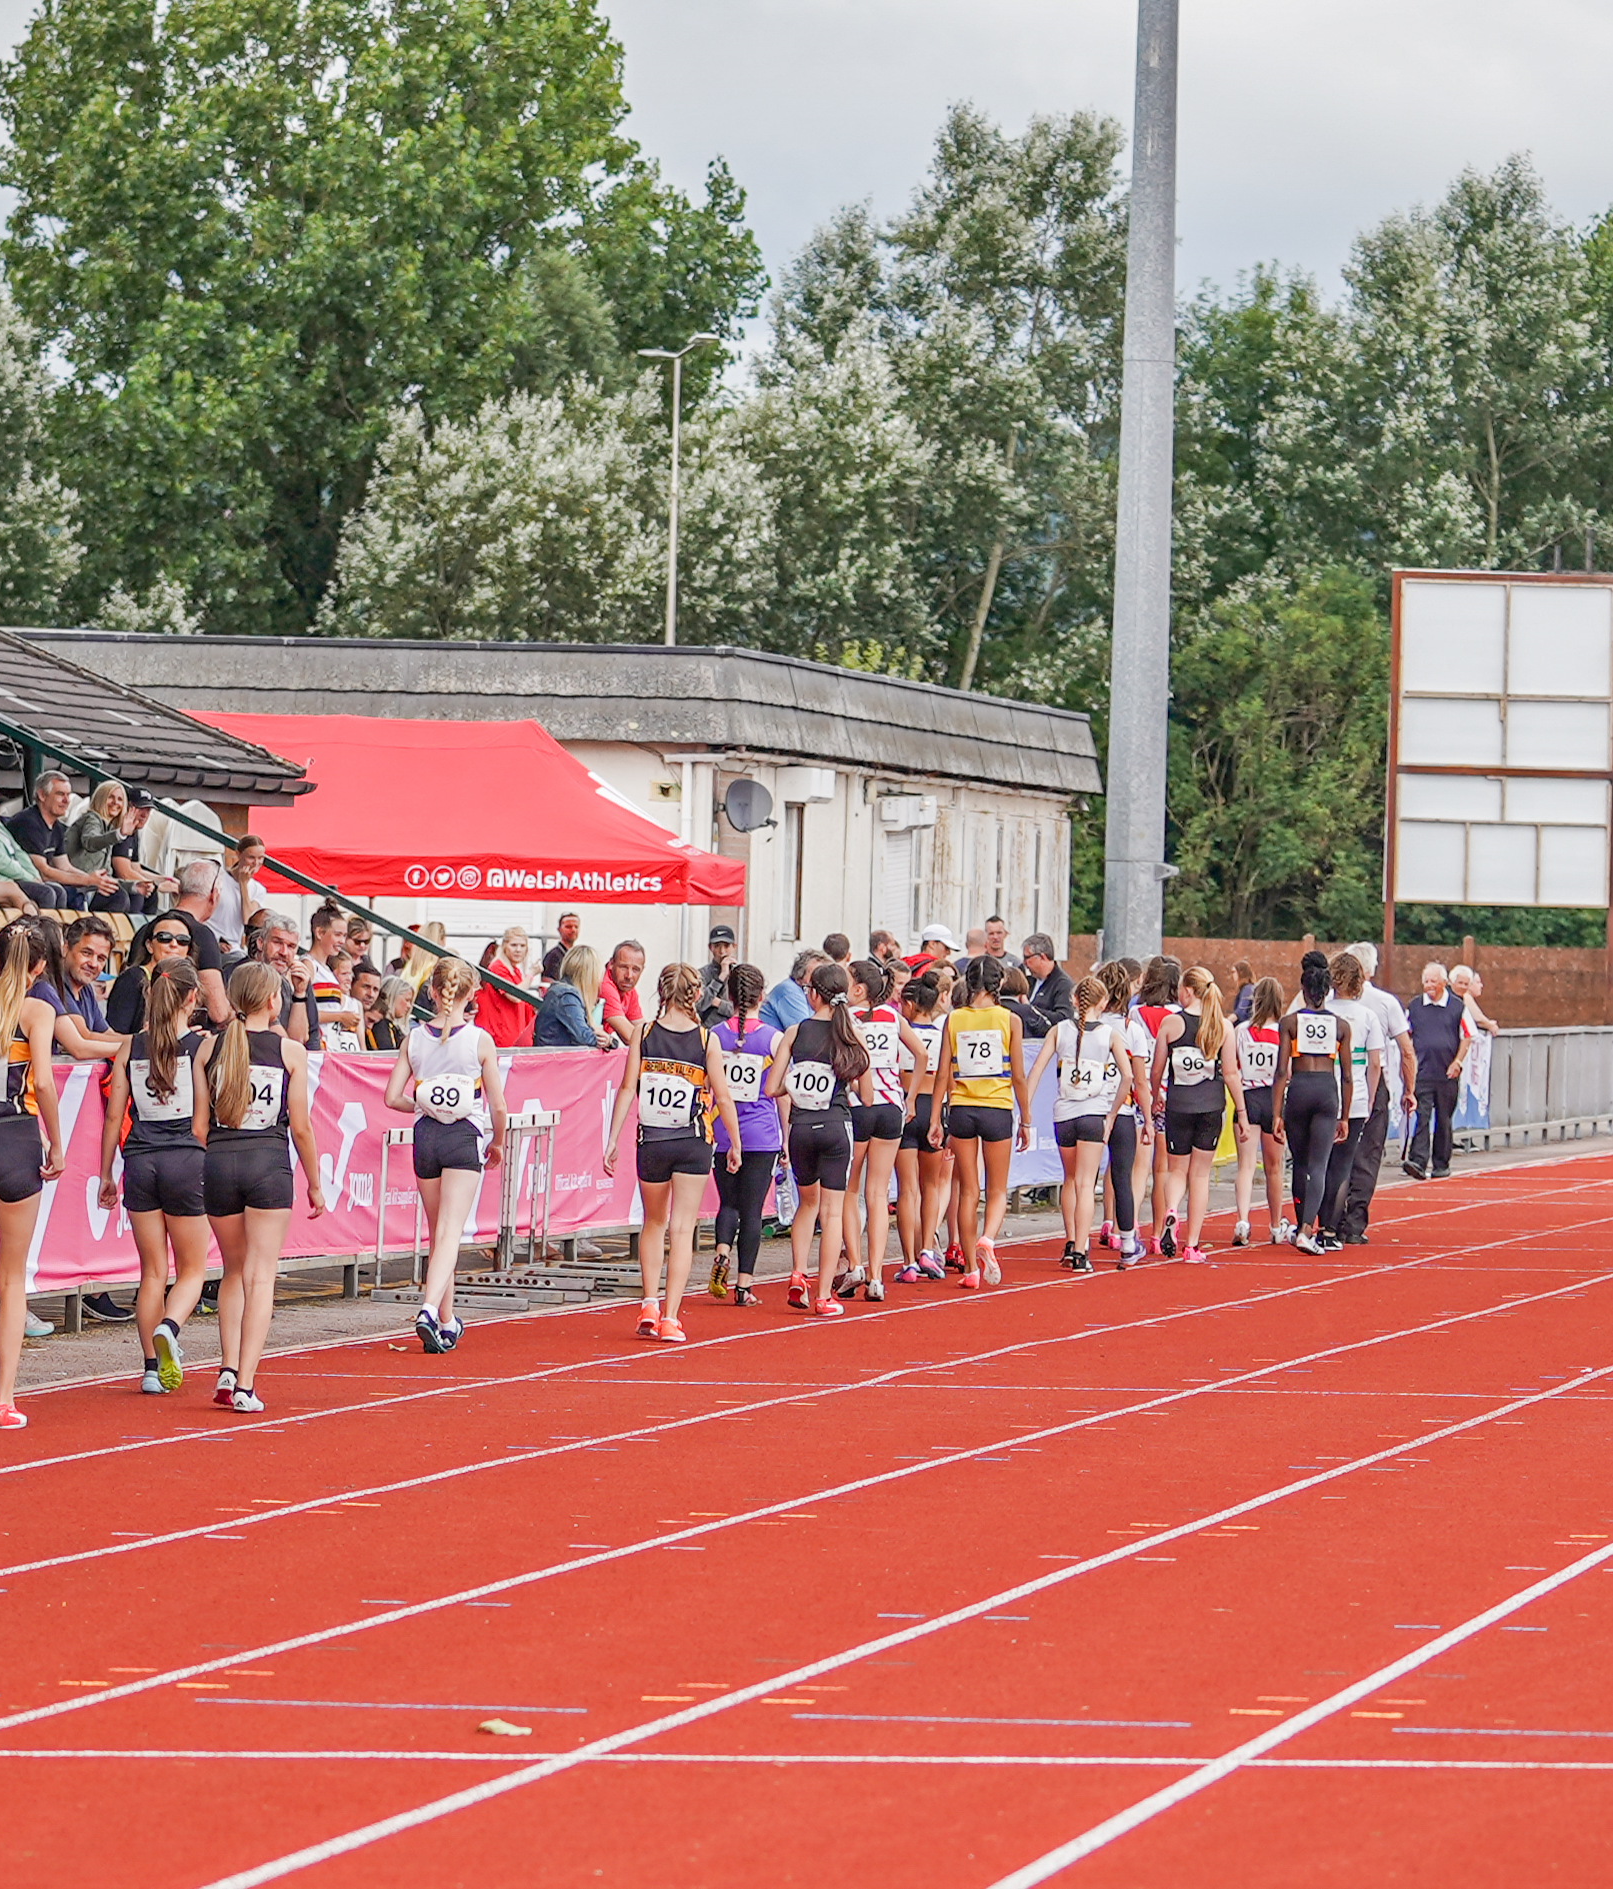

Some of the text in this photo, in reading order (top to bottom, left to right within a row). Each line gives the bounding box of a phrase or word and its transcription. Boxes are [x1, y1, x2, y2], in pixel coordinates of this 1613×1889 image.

[487, 868, 662, 892] @WelshAthletics
[1306, 1024, 1327, 1039] 93
[865, 1034, 889, 1050] 82
[967, 1042, 991, 1059] 78
[1183, 1057, 1204, 1071] 96
[1247, 1052, 1274, 1067] 101
[793, 1072, 830, 1093] 100
[1070, 1068, 1092, 1085] 84
[430, 1085, 460, 1107] 89
[646, 1086, 687, 1110] 102
